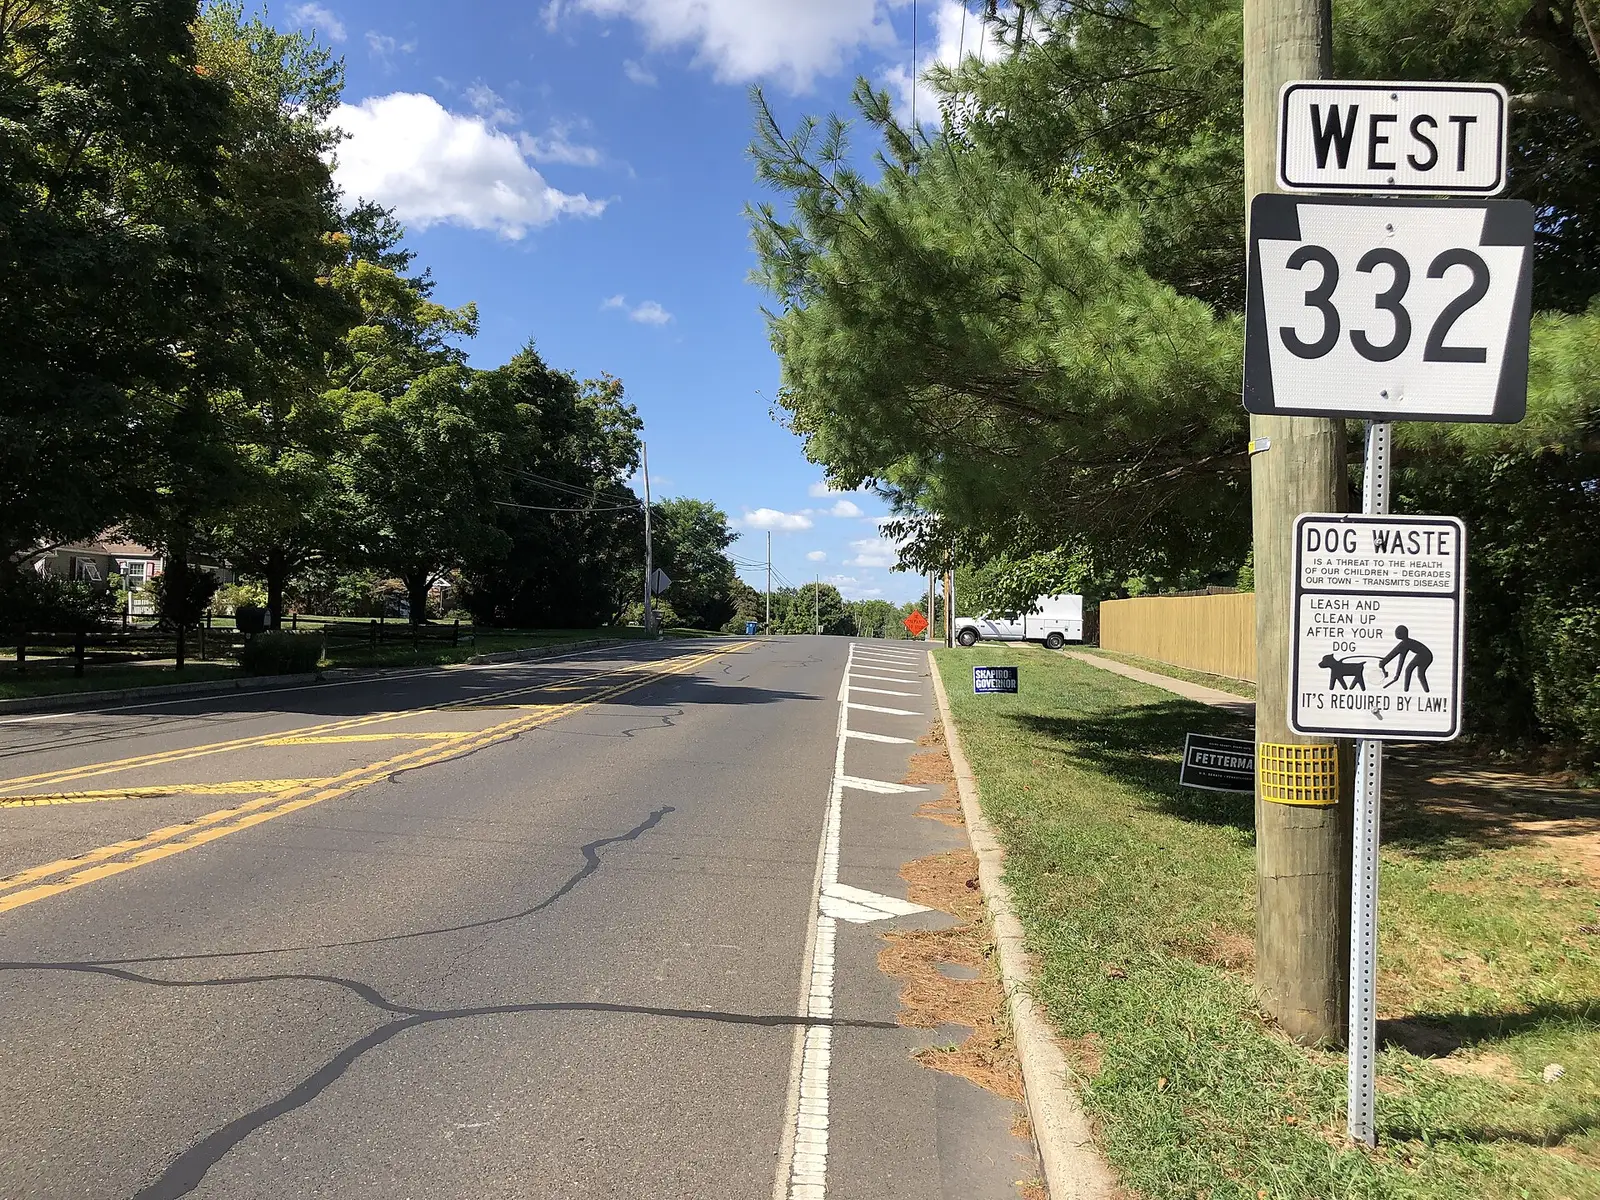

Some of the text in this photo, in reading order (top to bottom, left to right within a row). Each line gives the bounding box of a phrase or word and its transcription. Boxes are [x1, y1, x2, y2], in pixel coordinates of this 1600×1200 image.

[1309, 103, 1478, 172] WEST
[1279, 244, 1491, 364] 332
[1307, 527, 1450, 555] DOG WASTE
[1313, 558, 1442, 569] IS A THREAT TO THE HEALTH
[1305, 567, 1317, 575] OF
[1321, 567, 1340, 575] OUR
[1343, 568, 1389, 577] CHILDREN
[1402, 569, 1451, 579] DEGRADES
[1306, 576, 1324, 584] OUR
[1327, 577, 1351, 585] TOWN
[1362, 578, 1410, 587] TRANSMITS
[1413, 579, 1450, 588] DISEASE
[1310, 598, 1380, 611] LEASH AND
[1314, 612, 1376, 625] CLEAN UP
[1306, 626, 1383, 639] AFTER YOUR
[1332, 641, 1356, 652] DOG
[975, 669, 1009, 679] SHAPIRO
[975, 679, 1016, 689] GOVERNOR
[1302, 692, 1447, 713] IT'S REQUIRED BY LAW!
[1195, 752, 1255, 770] FETTERMA
